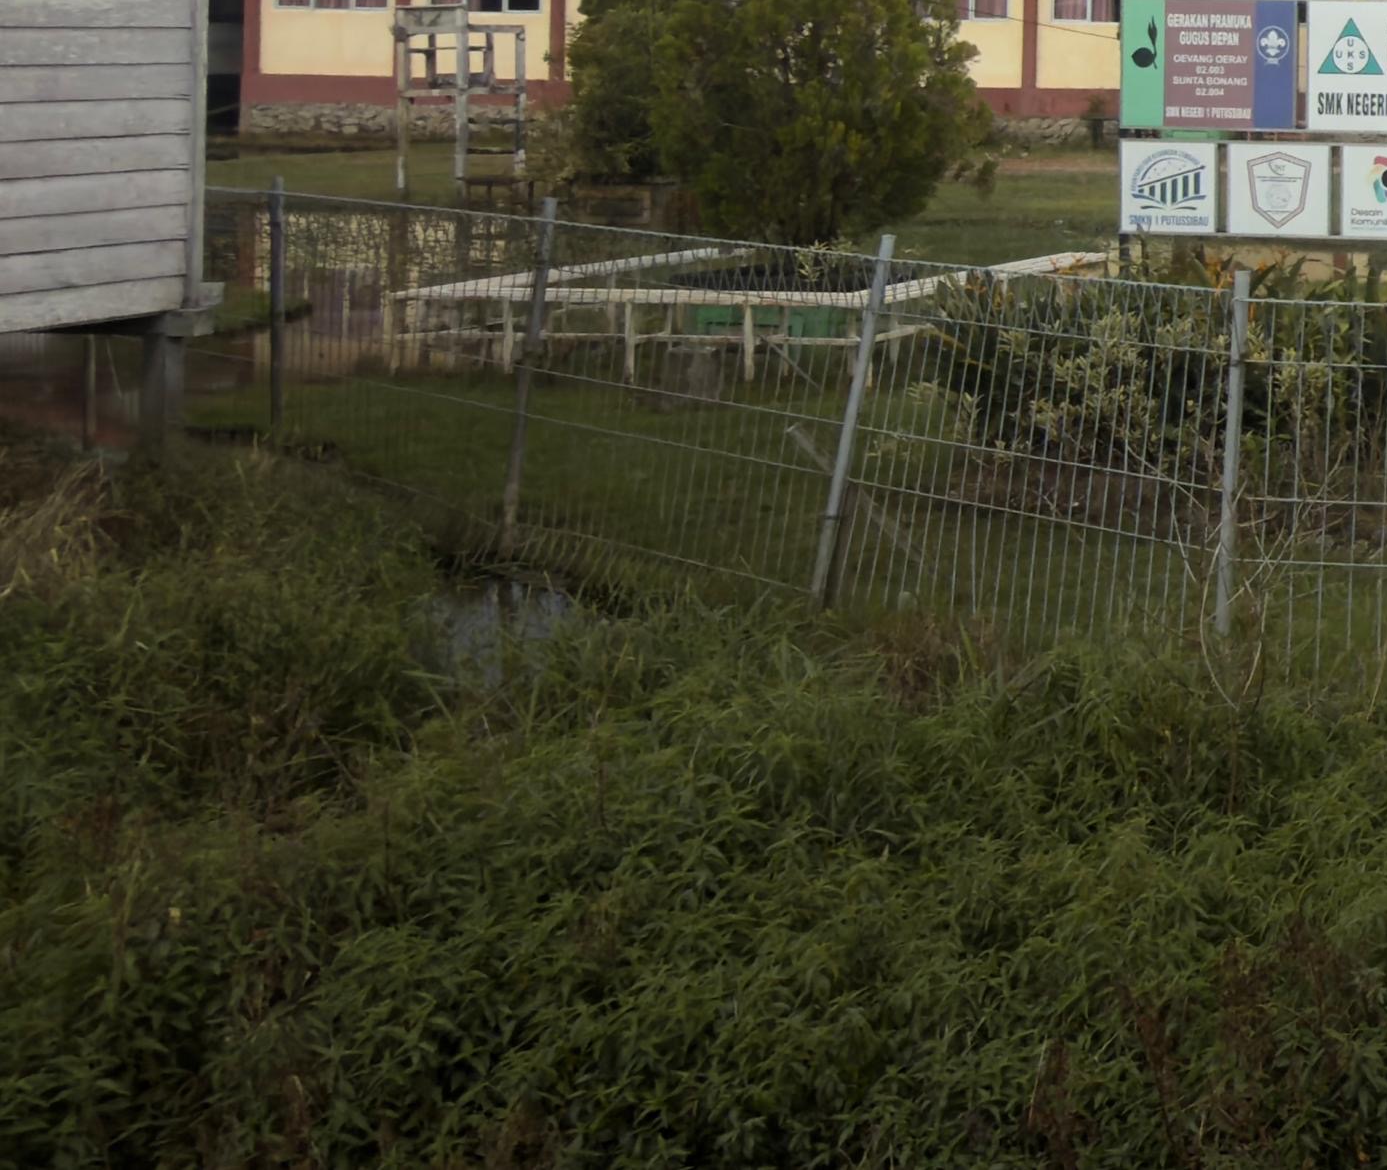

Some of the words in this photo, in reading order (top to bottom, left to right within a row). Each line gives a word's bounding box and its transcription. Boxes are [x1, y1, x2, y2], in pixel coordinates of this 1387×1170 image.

[1167, 13, 1208, 27] GERAKAN
[1210, 14, 1252, 28] PRAMUKA
[1179, 31, 1209, 45] GUGUS
[1211, 32, 1239, 46] DEPAN
[1318, 92, 1343, 115] SMK
[1351, 208, 1383, 216] Desain
